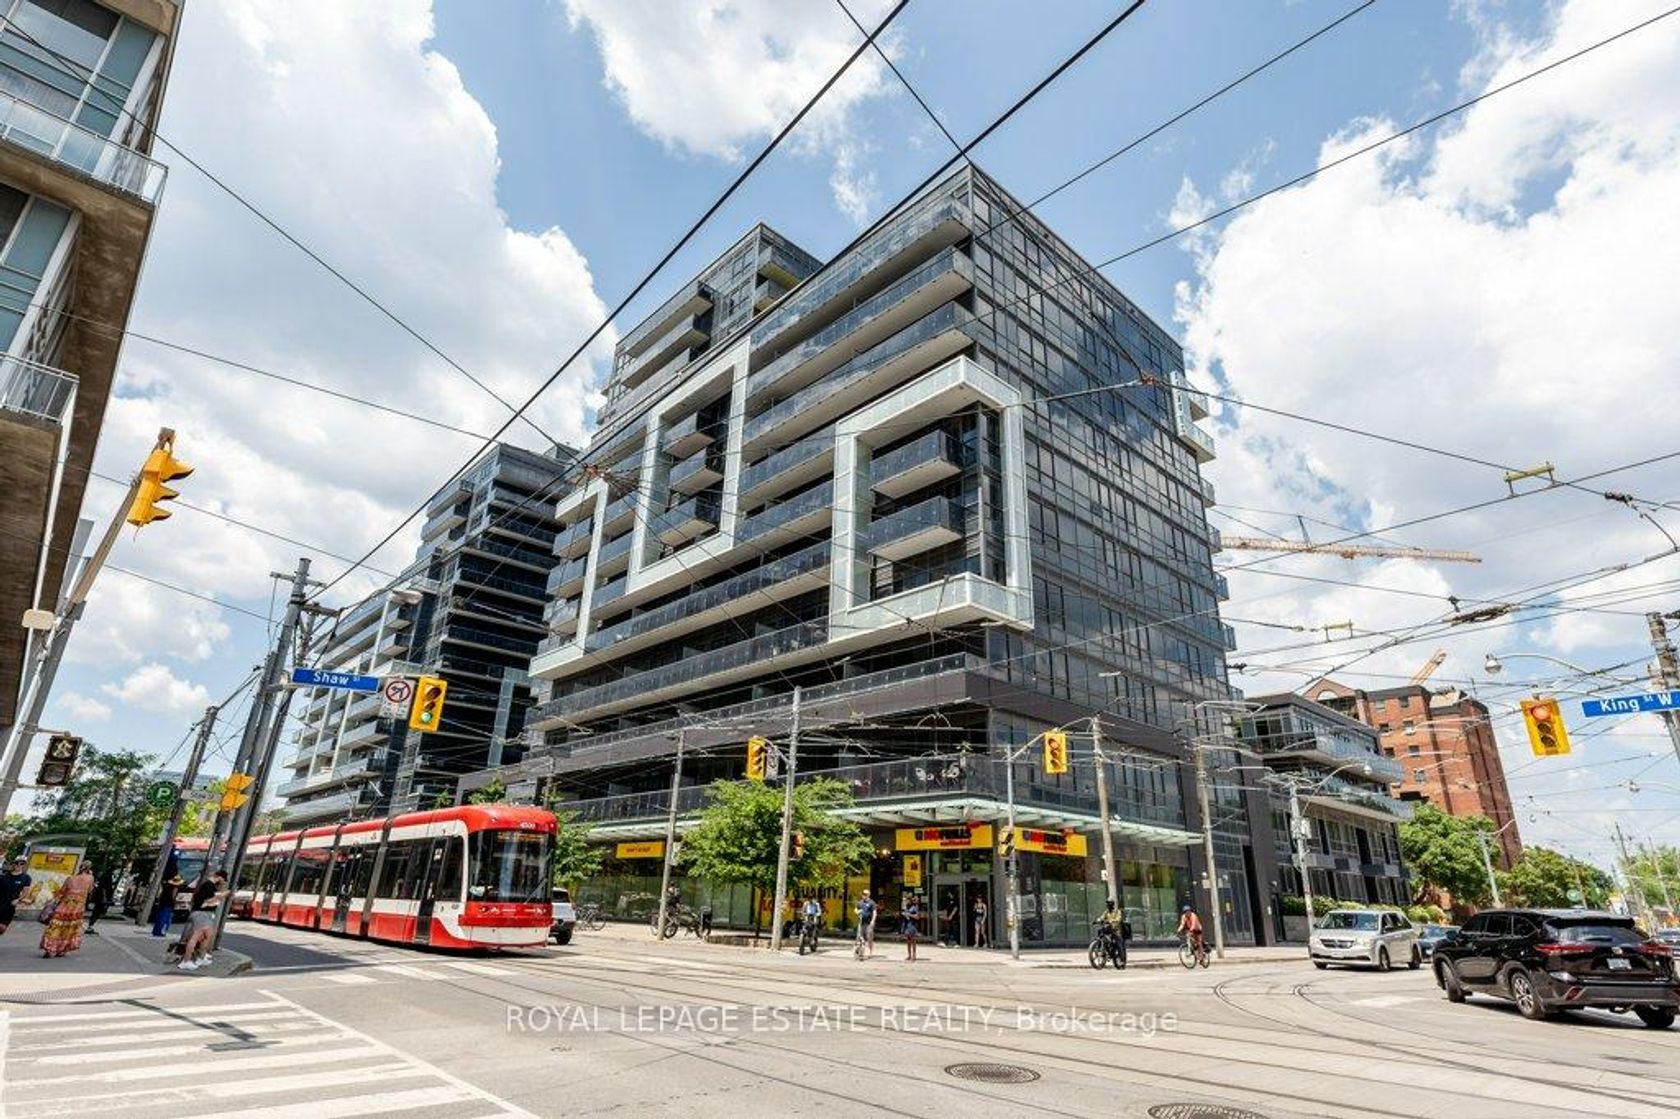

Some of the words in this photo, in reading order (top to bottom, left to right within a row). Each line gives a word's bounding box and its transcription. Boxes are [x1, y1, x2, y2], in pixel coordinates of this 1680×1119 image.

[313, 671, 349, 685] Shaw
[1600, 698, 1640, 712] King
[1657, 692, 1672, 706] W
